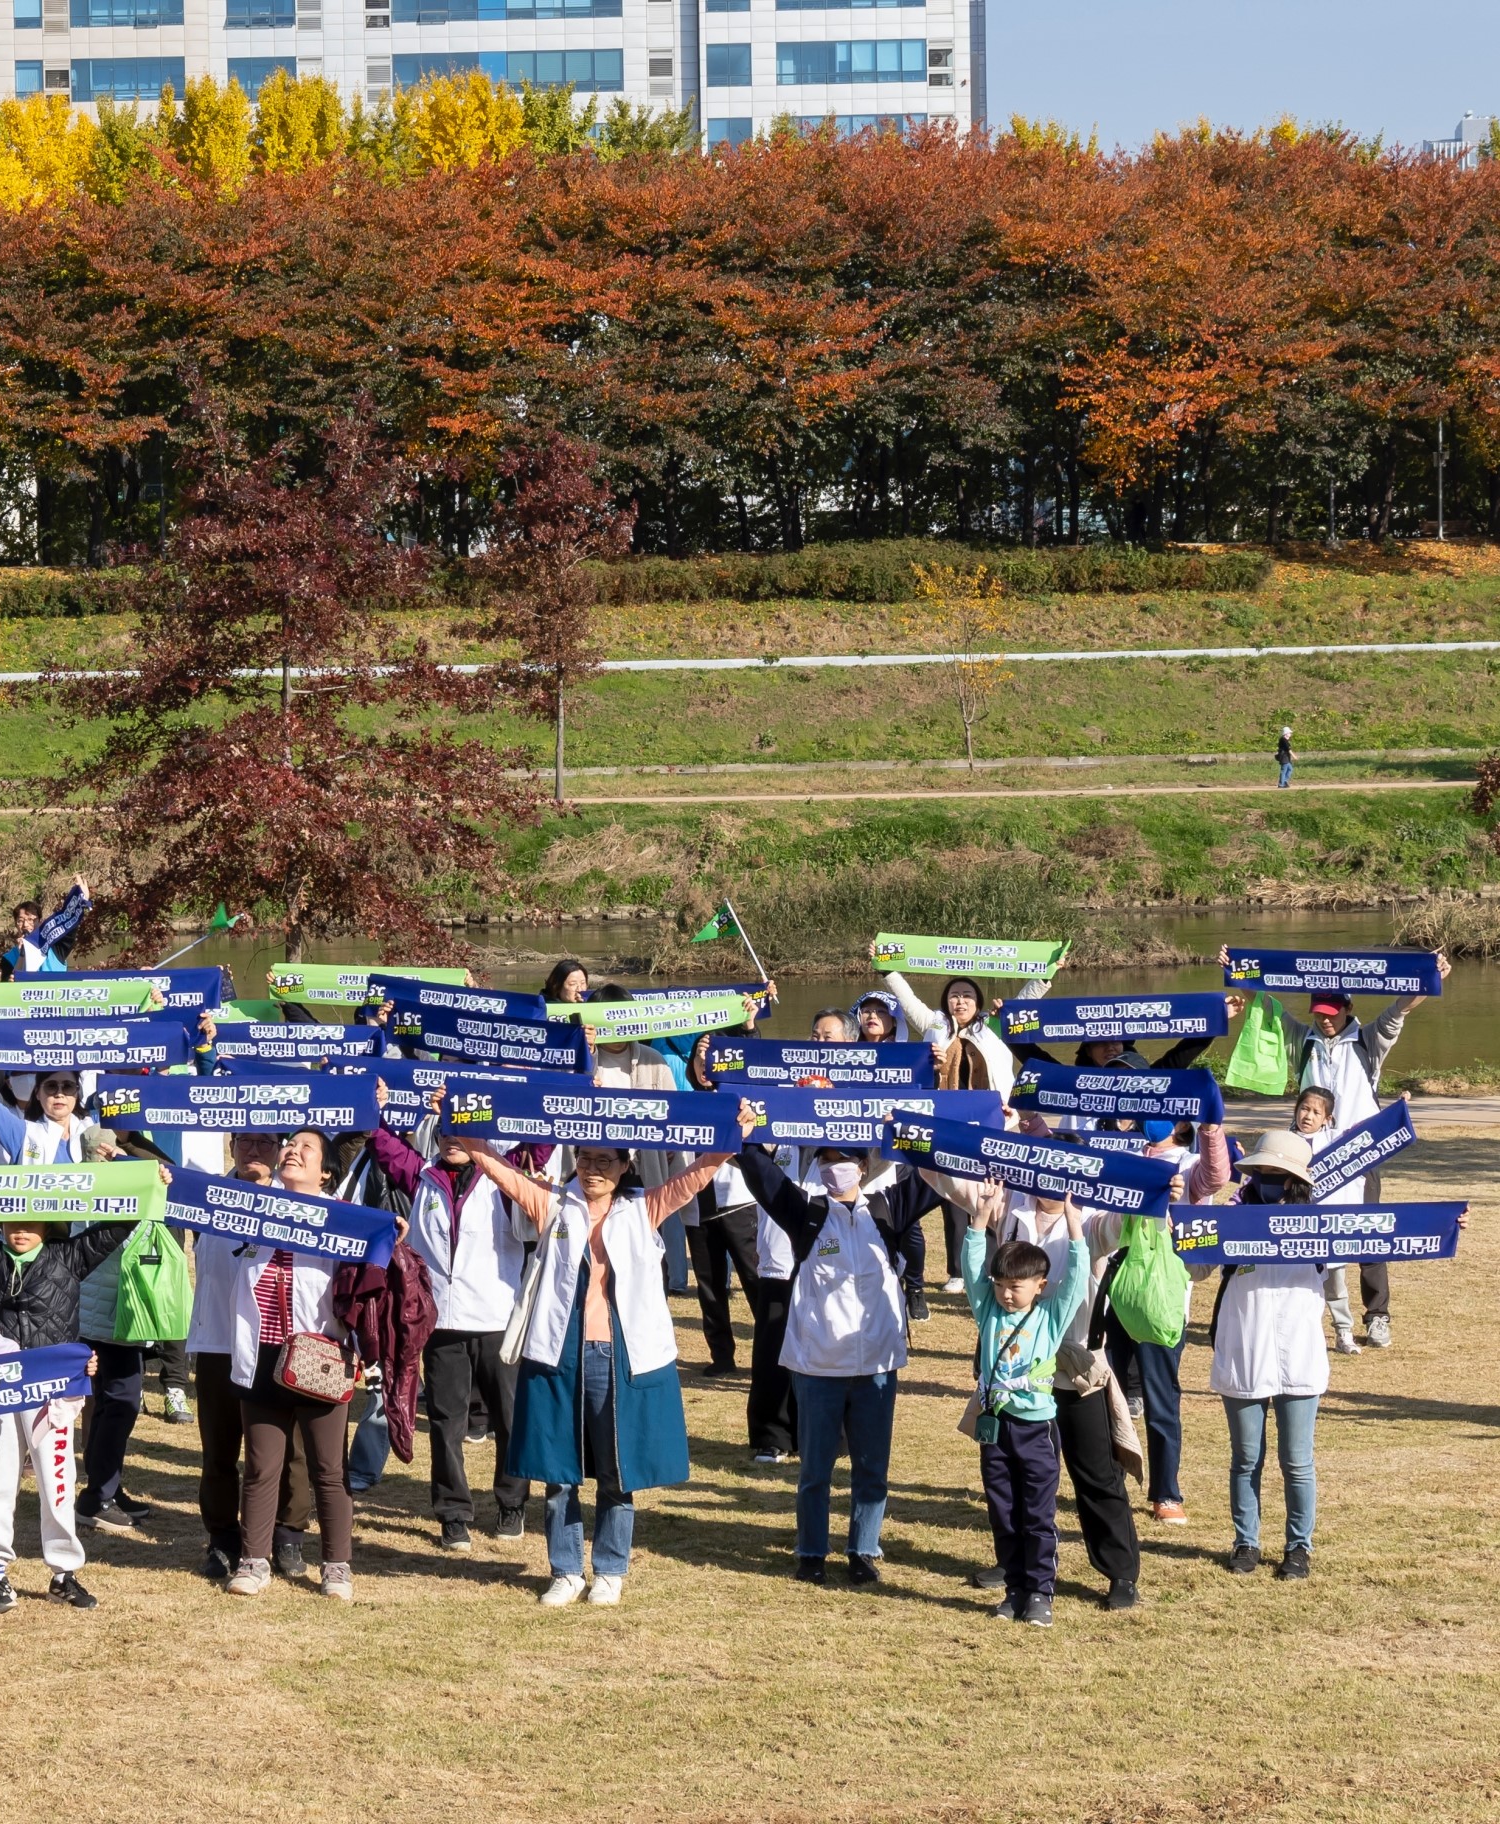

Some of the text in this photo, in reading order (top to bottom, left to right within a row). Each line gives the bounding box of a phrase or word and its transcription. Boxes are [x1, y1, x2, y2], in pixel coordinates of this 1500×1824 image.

[1296, 959, 1387, 974] 광명시 기후주간
[1264, 974, 1420, 991] 함께하는 광명!! 함께 사는 지구!!
[1076, 1002, 1171, 1019] 광명시 기후주간
[24, 1028, 128, 1045] 광명시 기후주간
[1043, 1018, 1206, 1037] 함께하는 광명!! 함께 사는 지구!!
[33, 1049, 73, 1066] 광명!!
[77, 1050, 100, 1064] 함께
[100, 1049, 126, 1063] 사는
[127, 1046, 166, 1062] 지구!!
[189, 1085, 310, 1104] 광명시 기후주간
[543, 1095, 669, 1119] 광명시 기후주간
[145, 1108, 354, 1127] 함께하는 광명!! 함께 사는 지구!!
[498, 1117, 714, 1145] 함께하는 광명!! 함께 사는 지구!!
[981, 1138, 1104, 1177] 광명시 기후주간
[22, 1173, 95, 1191] 기후주간
[935, 1150, 1143, 1208] 함께하는 광명!! 함께 사는 지구!!
[32, 1198, 60, 1212] 함께
[61, 1198, 88, 1213] 사는
[92, 1196, 138, 1214] 지구!!
[1269, 1215, 1396, 1234] 광명시 기후주간
[1223, 1236, 1440, 1257] 함께하는 광명!! 함께 사는 지구!!
[53, 1425, 68, 1507] TRAVEL
